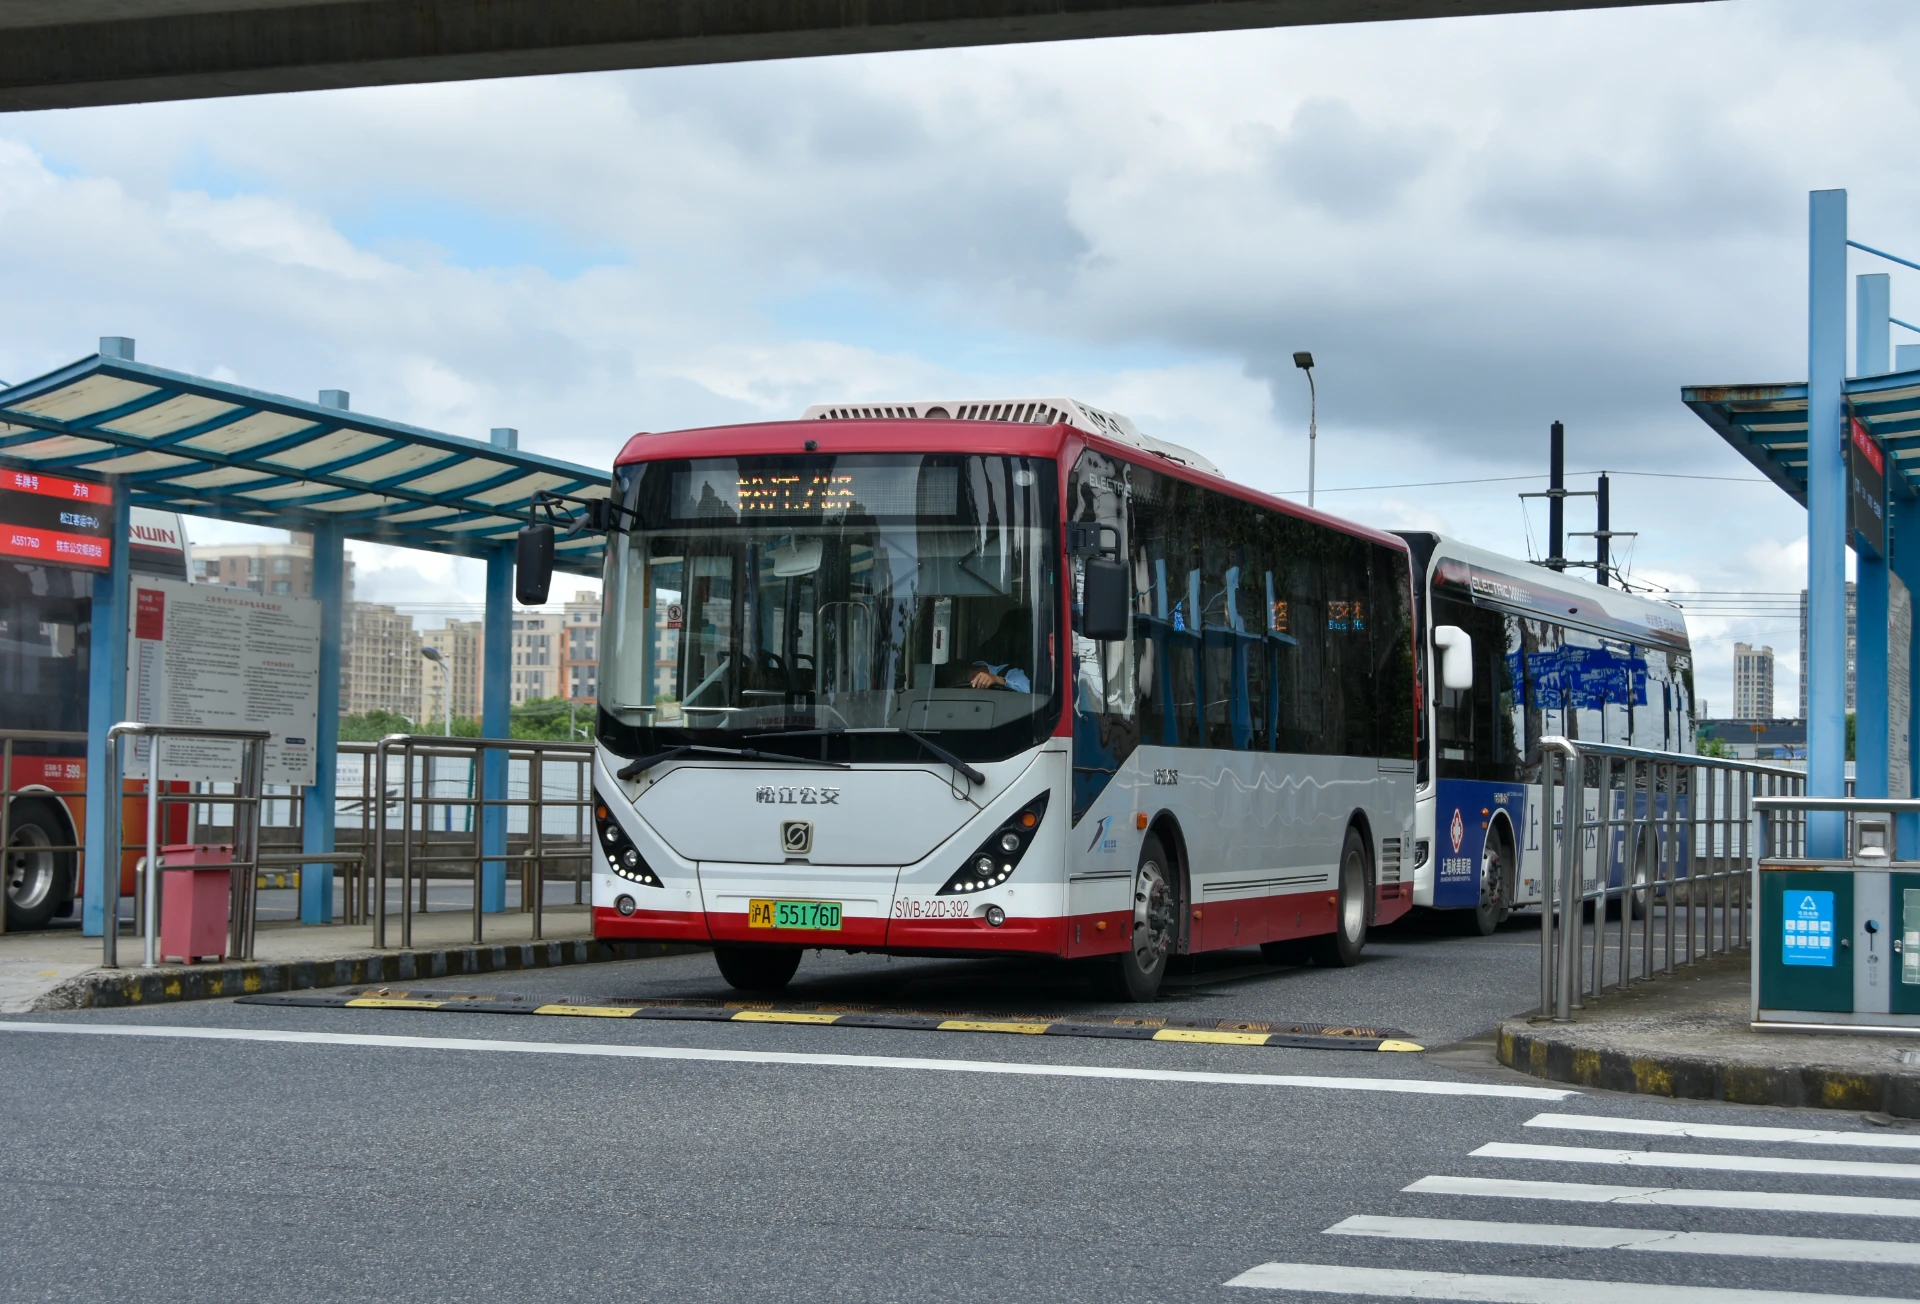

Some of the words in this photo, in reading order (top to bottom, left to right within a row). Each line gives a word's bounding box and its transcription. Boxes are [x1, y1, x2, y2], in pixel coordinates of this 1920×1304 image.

[15, 474, 39, 490] 车牌号
[73, 483, 89, 497] 方向
[11, 535, 40, 548] A55176D
[1471, 576, 1510, 598] ELECTRIC
[755, 785, 840, 805] 松江公交
[895, 899, 969, 918] SWB-22D-392
